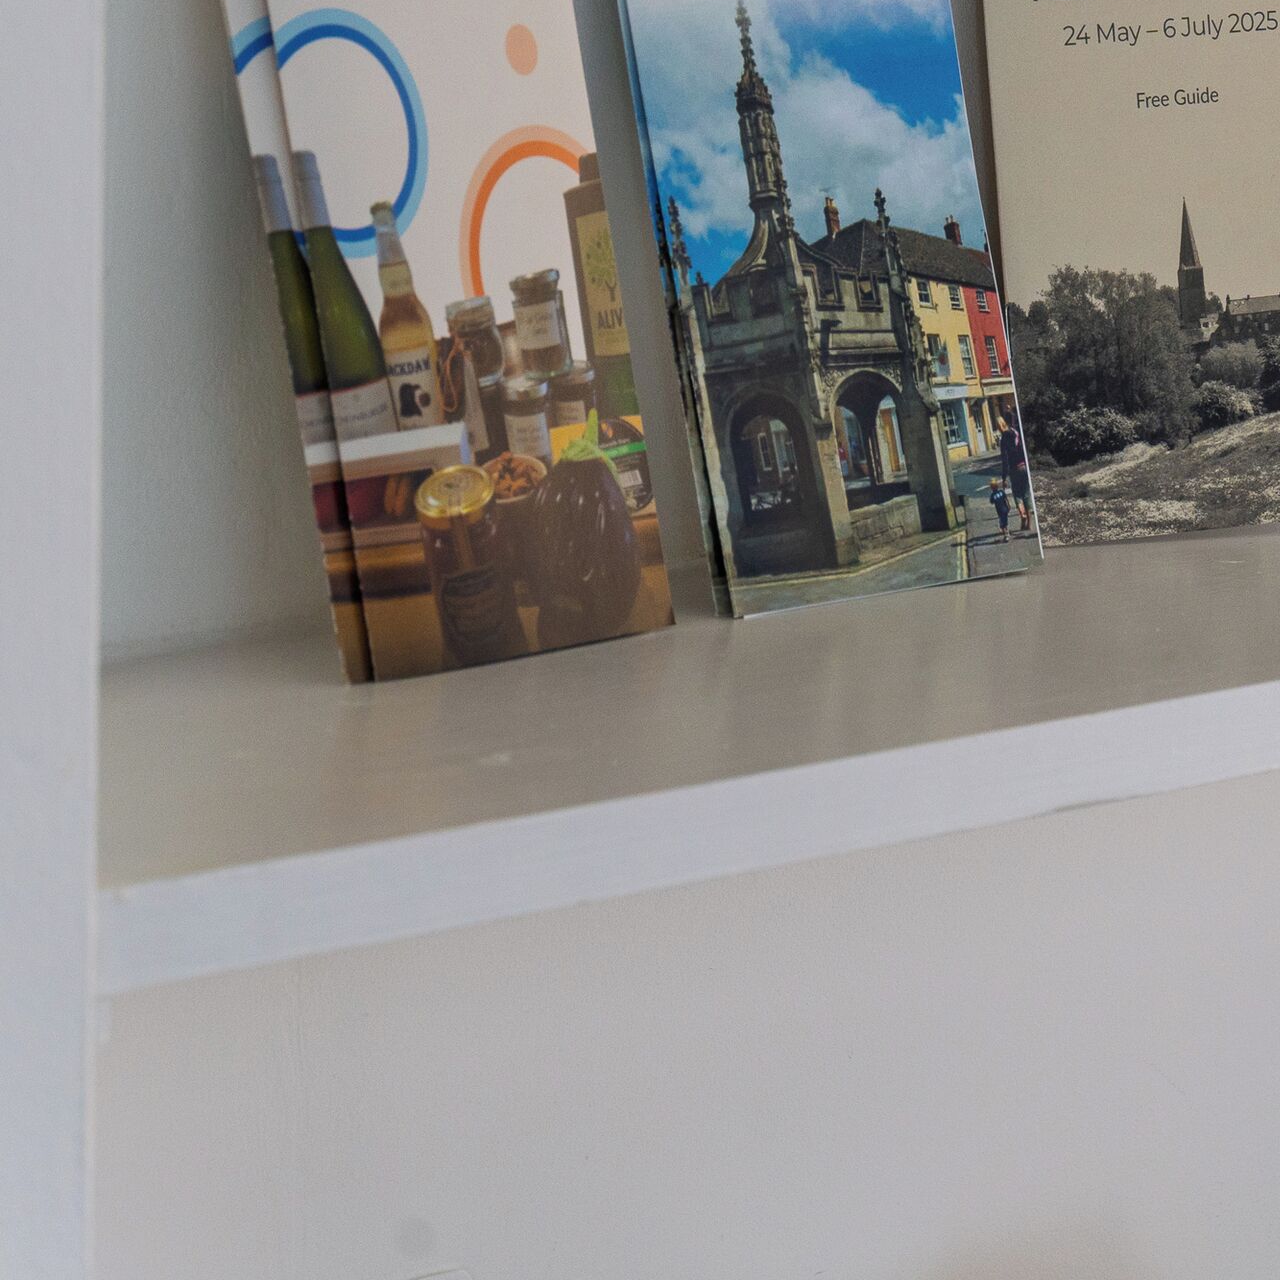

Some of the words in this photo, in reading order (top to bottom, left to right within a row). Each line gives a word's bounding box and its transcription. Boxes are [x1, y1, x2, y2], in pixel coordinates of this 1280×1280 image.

[1063, 24, 1091, 46] 24
[1097, 22, 1142, 46] May
[1163, 18, 1177, 38] 6
[1181, 14, 1224, 40] July
[1227, 11, 1279, 34] 2025
[1136, 91, 1170, 109] Free
[1174, 86, 1220, 107] Guide
